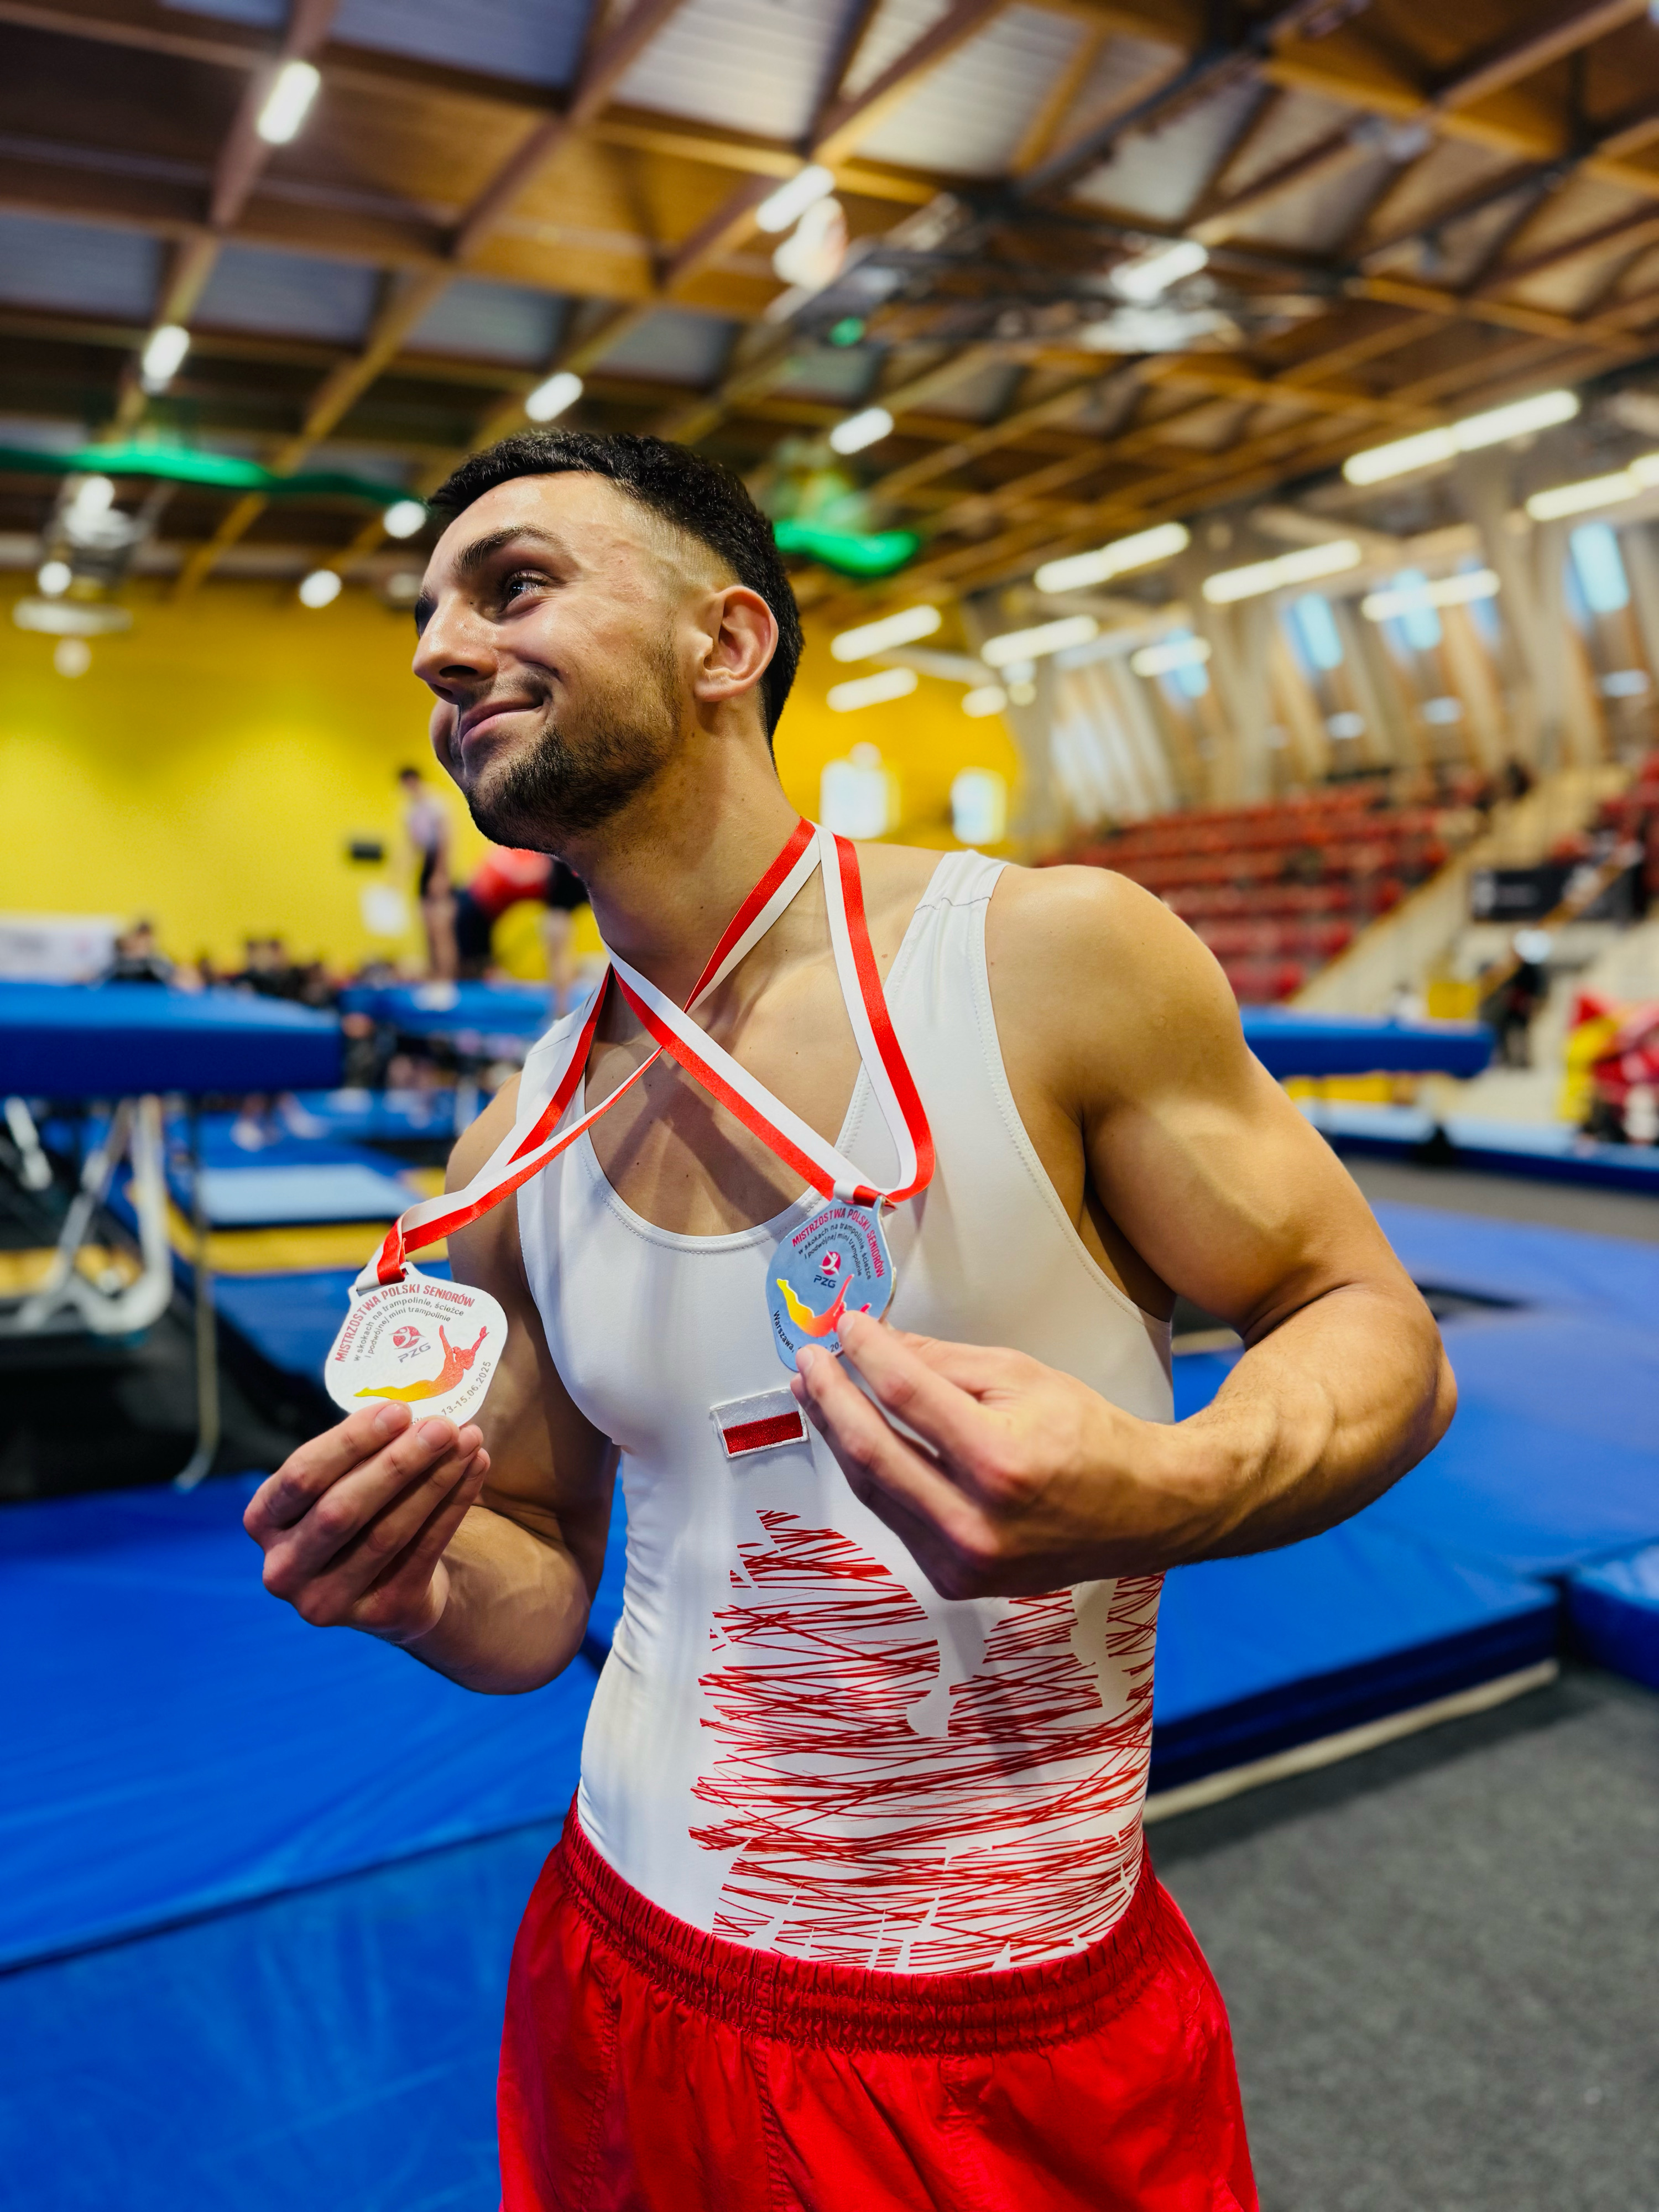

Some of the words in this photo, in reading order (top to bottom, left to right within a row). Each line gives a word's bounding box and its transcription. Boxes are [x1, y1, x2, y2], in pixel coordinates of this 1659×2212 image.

[792, 1208, 846, 1247] MISTRZOSTWA
[847, 1208, 872, 1232] POLSKI
[867, 1229, 885, 1278] SENIORÓW
[805, 1227, 828, 1250] skokach
[837, 1233, 850, 1241] mini
[848, 1238, 862, 1276] trampolinie
[813, 1275, 836, 1288] PZG
[335, 1296, 381, 1362] MISTRZOSTWA
[380, 1284, 420, 1300] POLSKI
[422, 1285, 475, 1307] SENIORÓW
[357, 1322, 374, 1353] skokach
[372, 1311, 383, 1321] na
[382, 1296, 432, 1312] trampolinie,
[434, 1301, 464, 1316] ścieżce
[368, 1316, 390, 1355] podwójnej
[389, 1307, 406, 1319] mini
[408, 1306, 450, 1322] trampolinie
[774, 1310, 794, 1353] Warszawa,
[398, 1342, 431, 1363] PZG
[441, 1361, 491, 1415] 13-15.06.2025
